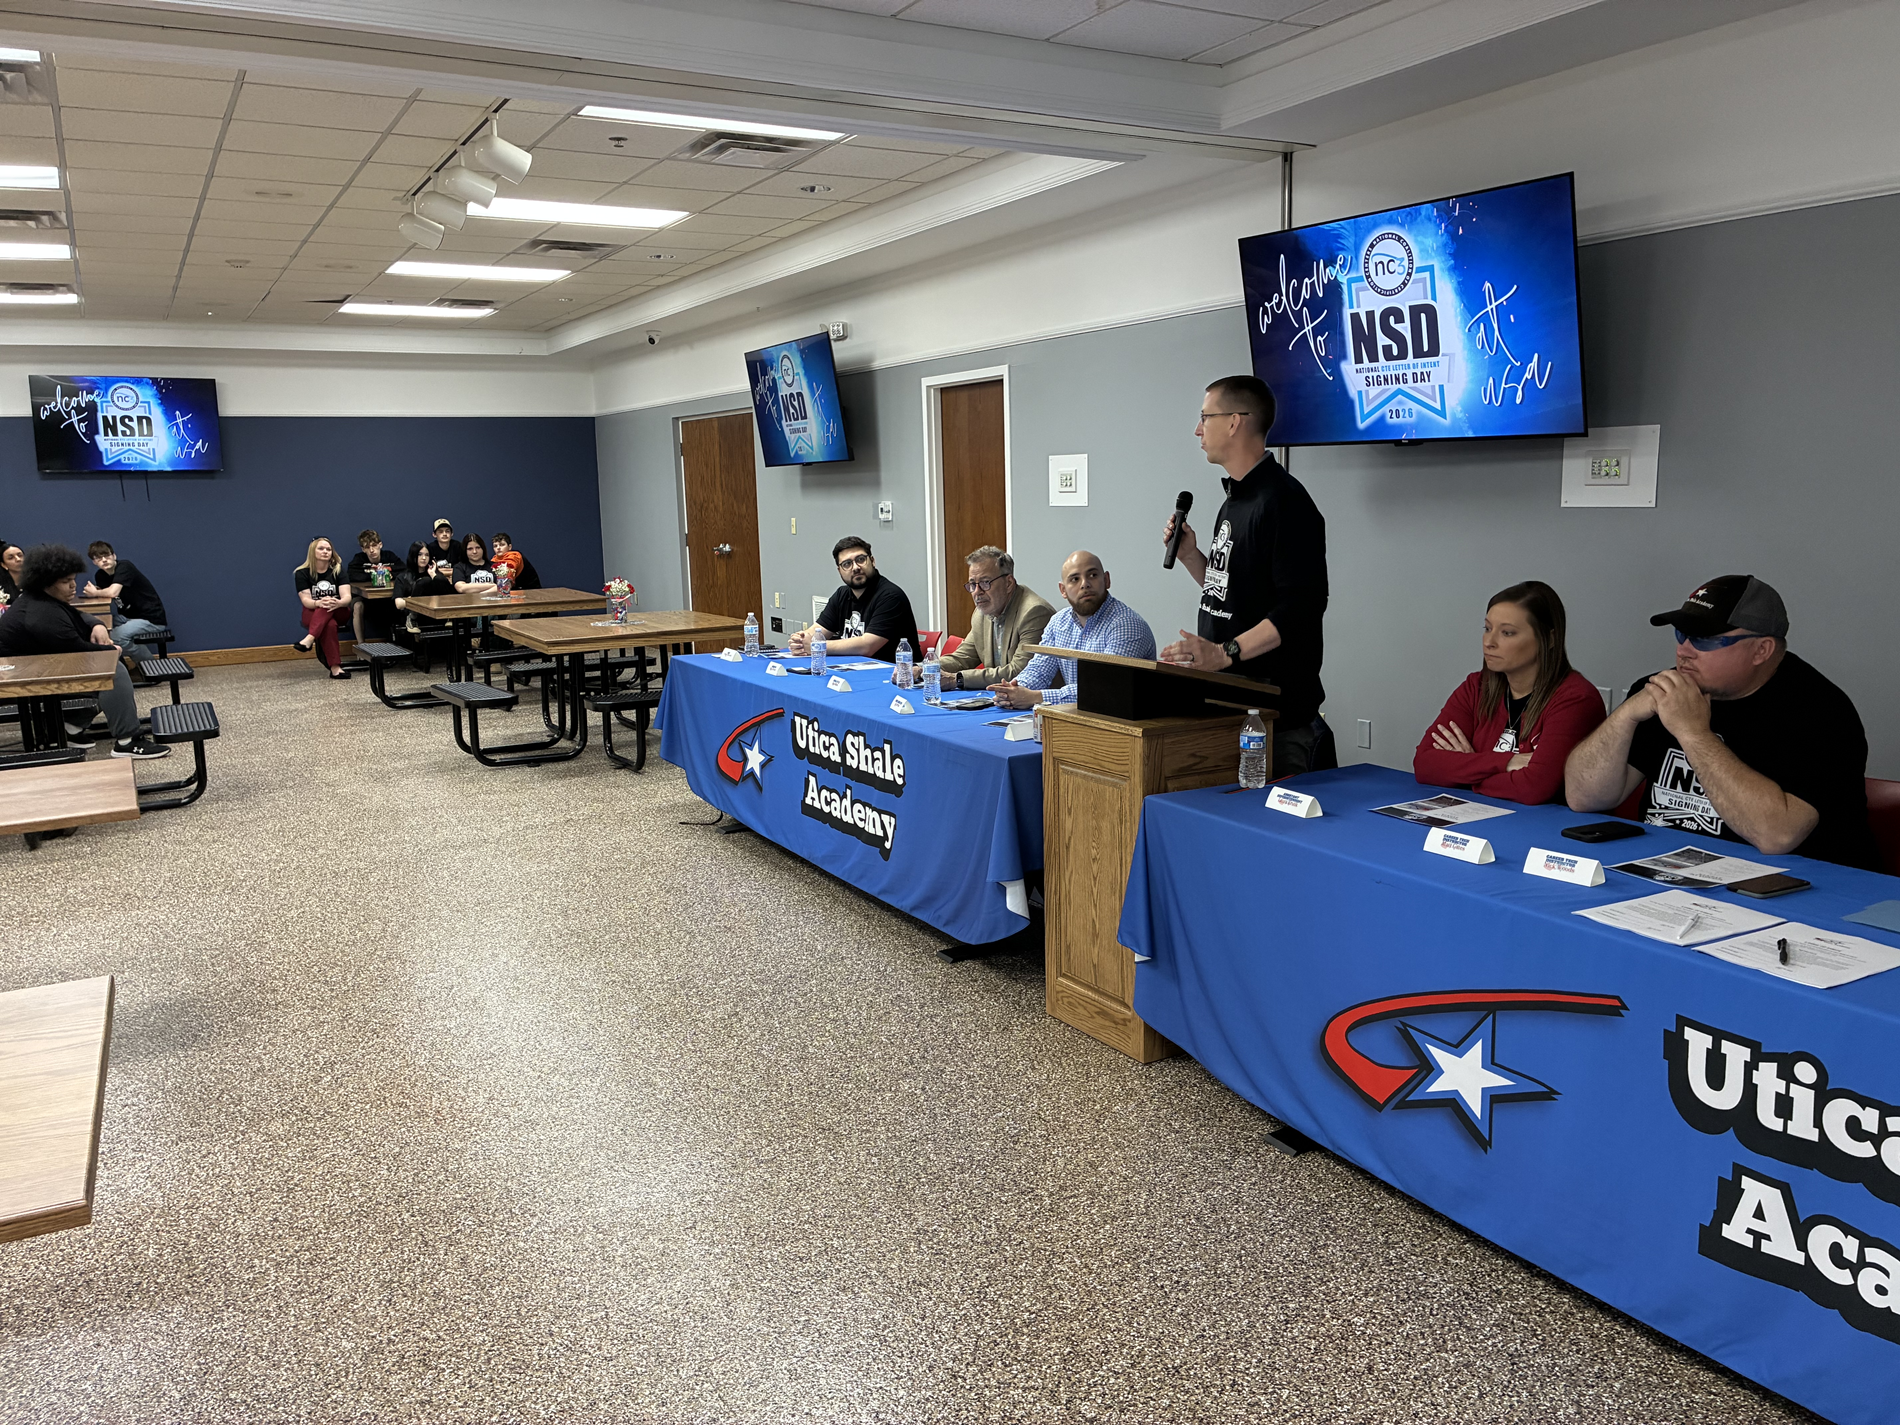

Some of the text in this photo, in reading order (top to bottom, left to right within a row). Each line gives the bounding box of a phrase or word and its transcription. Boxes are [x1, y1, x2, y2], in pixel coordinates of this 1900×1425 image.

[1372, 233, 1399, 246] NATIONAL
[1400, 239, 1413, 273] COALITION
[1259, 254, 1351, 334] welcome
[1289, 306, 1334, 381] to
[1350, 303, 1441, 365] NSD
[1355, 360, 1440, 375] NATIONAL CTE LETTER OF INTENT
[1364, 370, 1432, 388] SIGNING DAY
[40, 384, 104, 420] welcome
[781, 392, 808, 422] NSD
[1388, 407, 1414, 420] 2026
[60, 411, 91, 444] to
[101, 414, 154, 438] NSD
[474, 576, 492, 584] NSD
[794, 715, 905, 785] Utica Shale
[804, 774, 896, 850] Academy
[1667, 798, 1712, 816] SIGNING DAY
[1682, 819, 1698, 830] 2026
